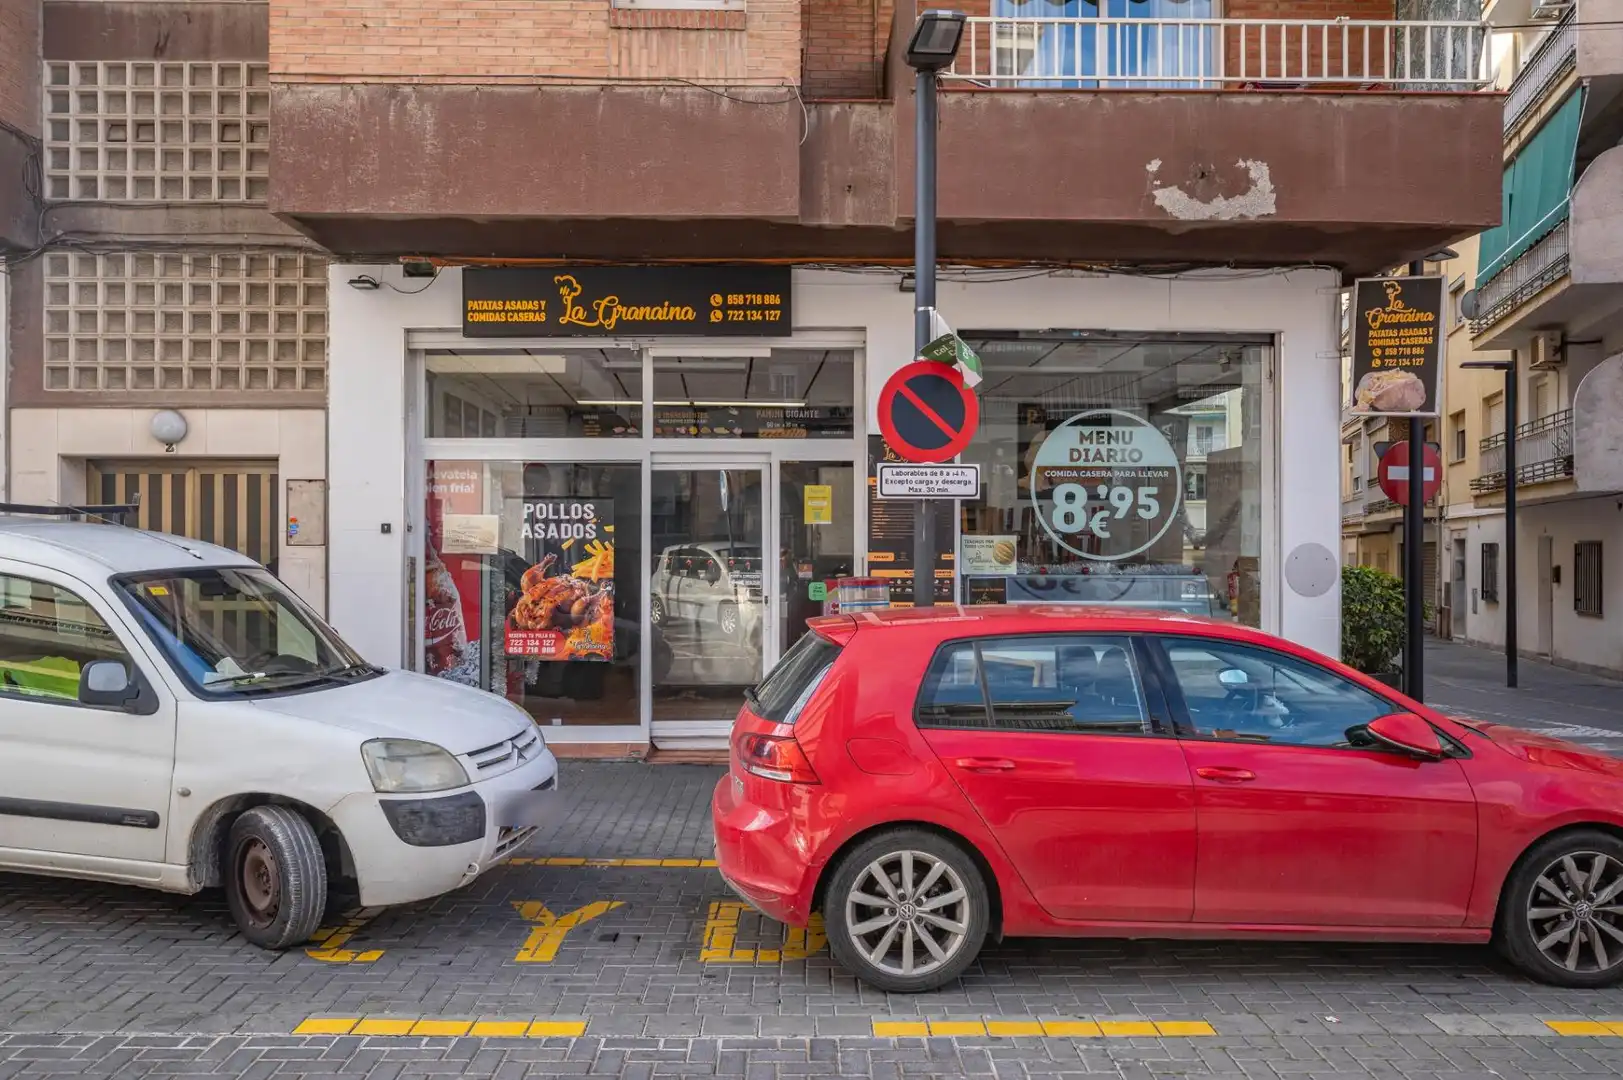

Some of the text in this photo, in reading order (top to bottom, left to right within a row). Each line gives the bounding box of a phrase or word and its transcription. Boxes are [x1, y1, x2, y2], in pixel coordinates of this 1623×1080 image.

[727, 294, 781, 305] 858 718 886
[1385, 293, 1412, 312] La
[467, 300, 546, 311] PATATAS ASADAS Y
[467, 312, 546, 323] COMIDAS CASERAS
[558, 295, 697, 330] La Granaina
[727, 310, 781, 321] 722 134 127
[1365, 307, 1435, 329] Granaina
[1368, 327, 1434, 338] PATATAS ASADAS Y
[1368, 336, 1433, 347] COMIDAS CASERAS
[1384, 347, 1424, 356] 858 718 886
[1384, 358, 1424, 366] 722 134 127
[1079, 430, 1134, 445] MENU
[1069, 448, 1144, 463] DIARIO
[1044, 470, 1169, 478] COMIDA CASERA PARA LLEVAR
[884, 478, 913, 486] Excepto
[523, 502, 595, 520] POLLOS
[520, 523, 597, 539] ASADOS
[510, 900, 628, 963] Y
